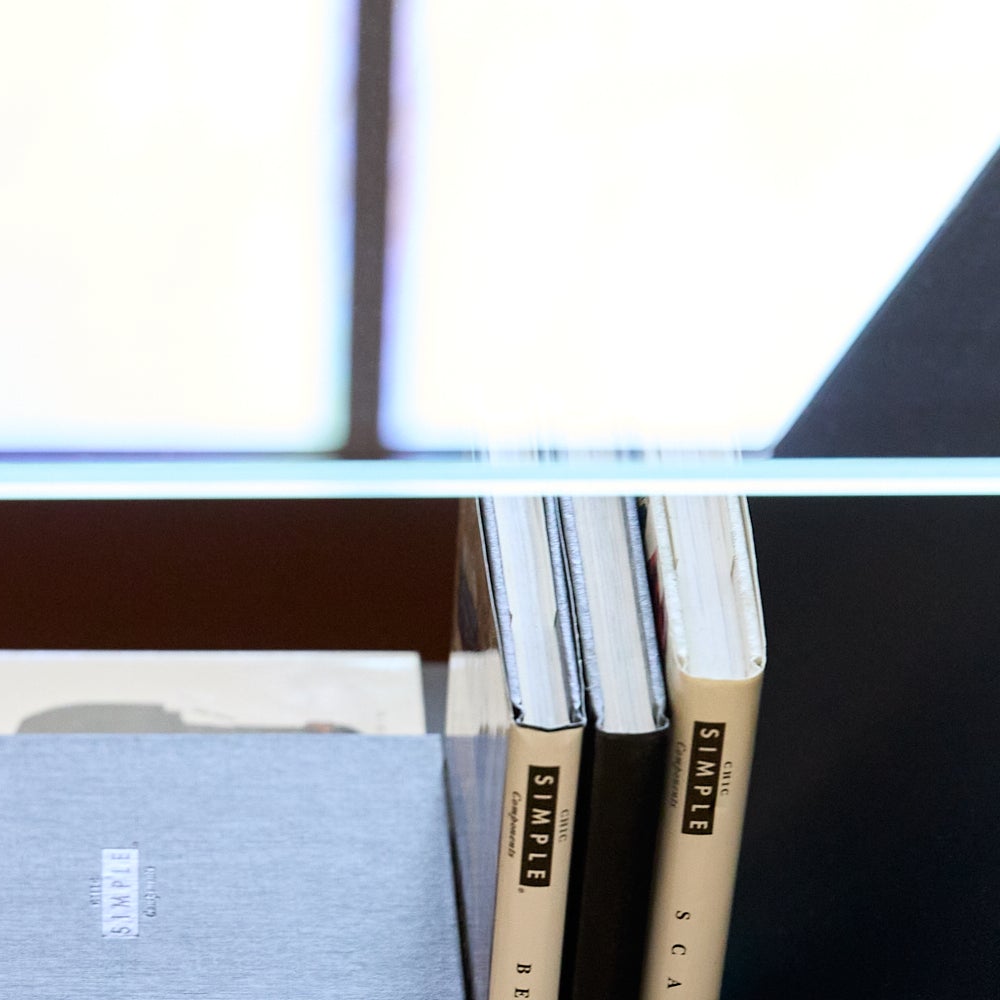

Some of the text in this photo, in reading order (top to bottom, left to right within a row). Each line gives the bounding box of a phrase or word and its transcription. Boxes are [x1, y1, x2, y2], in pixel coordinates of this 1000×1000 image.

[688, 727, 720, 830] SIMPLE
[720, 761, 733, 797] CHIC
[507, 790, 523, 859] Components
[525, 774, 555, 880] SIMPLE
[558, 809, 570, 844] CHIC
[110, 852, 131, 935] SIMPLE
